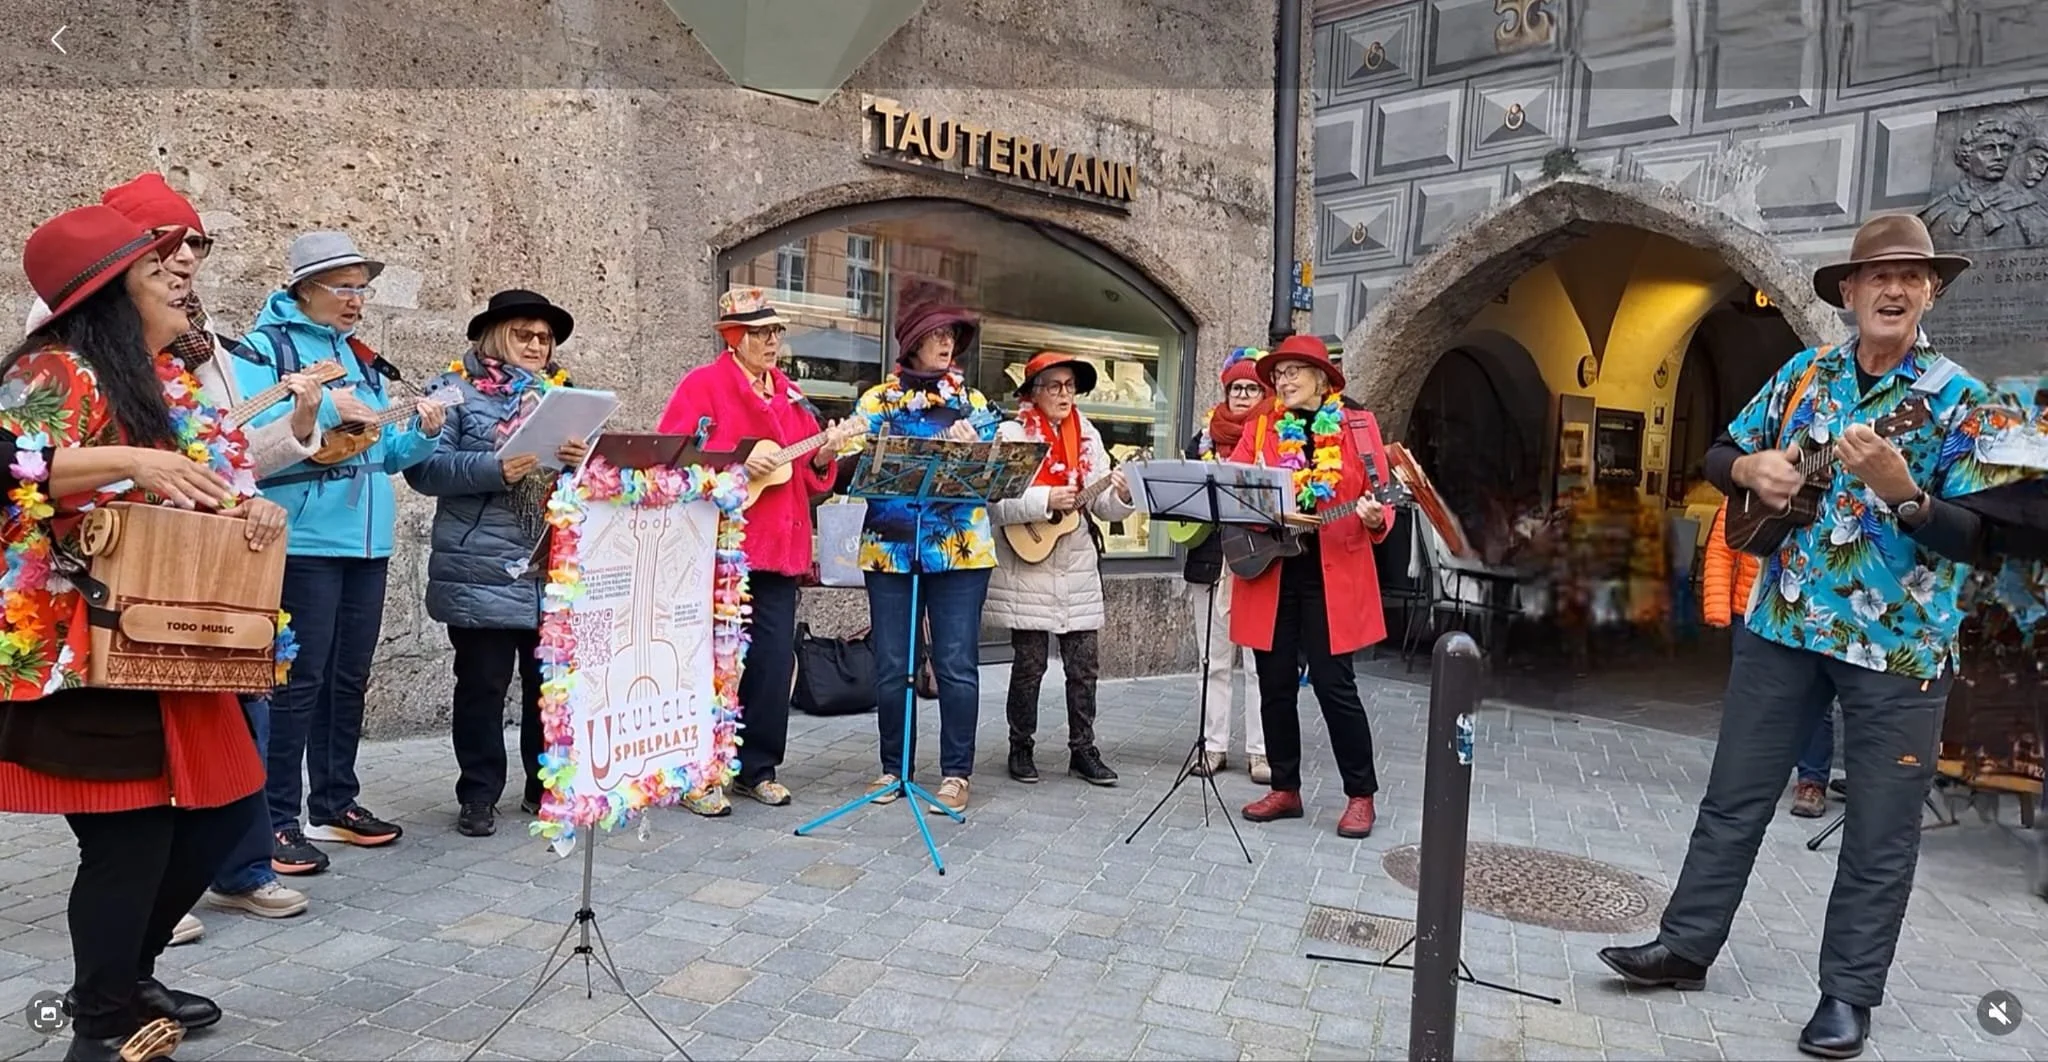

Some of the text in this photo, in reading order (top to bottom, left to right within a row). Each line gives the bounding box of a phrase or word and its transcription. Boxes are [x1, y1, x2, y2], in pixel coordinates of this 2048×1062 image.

[876, 103, 1137, 200] TAUTERMANN
[167, 622, 235, 634] TODO MUSIC
[615, 724, 698, 762] SPIELPLATZ
